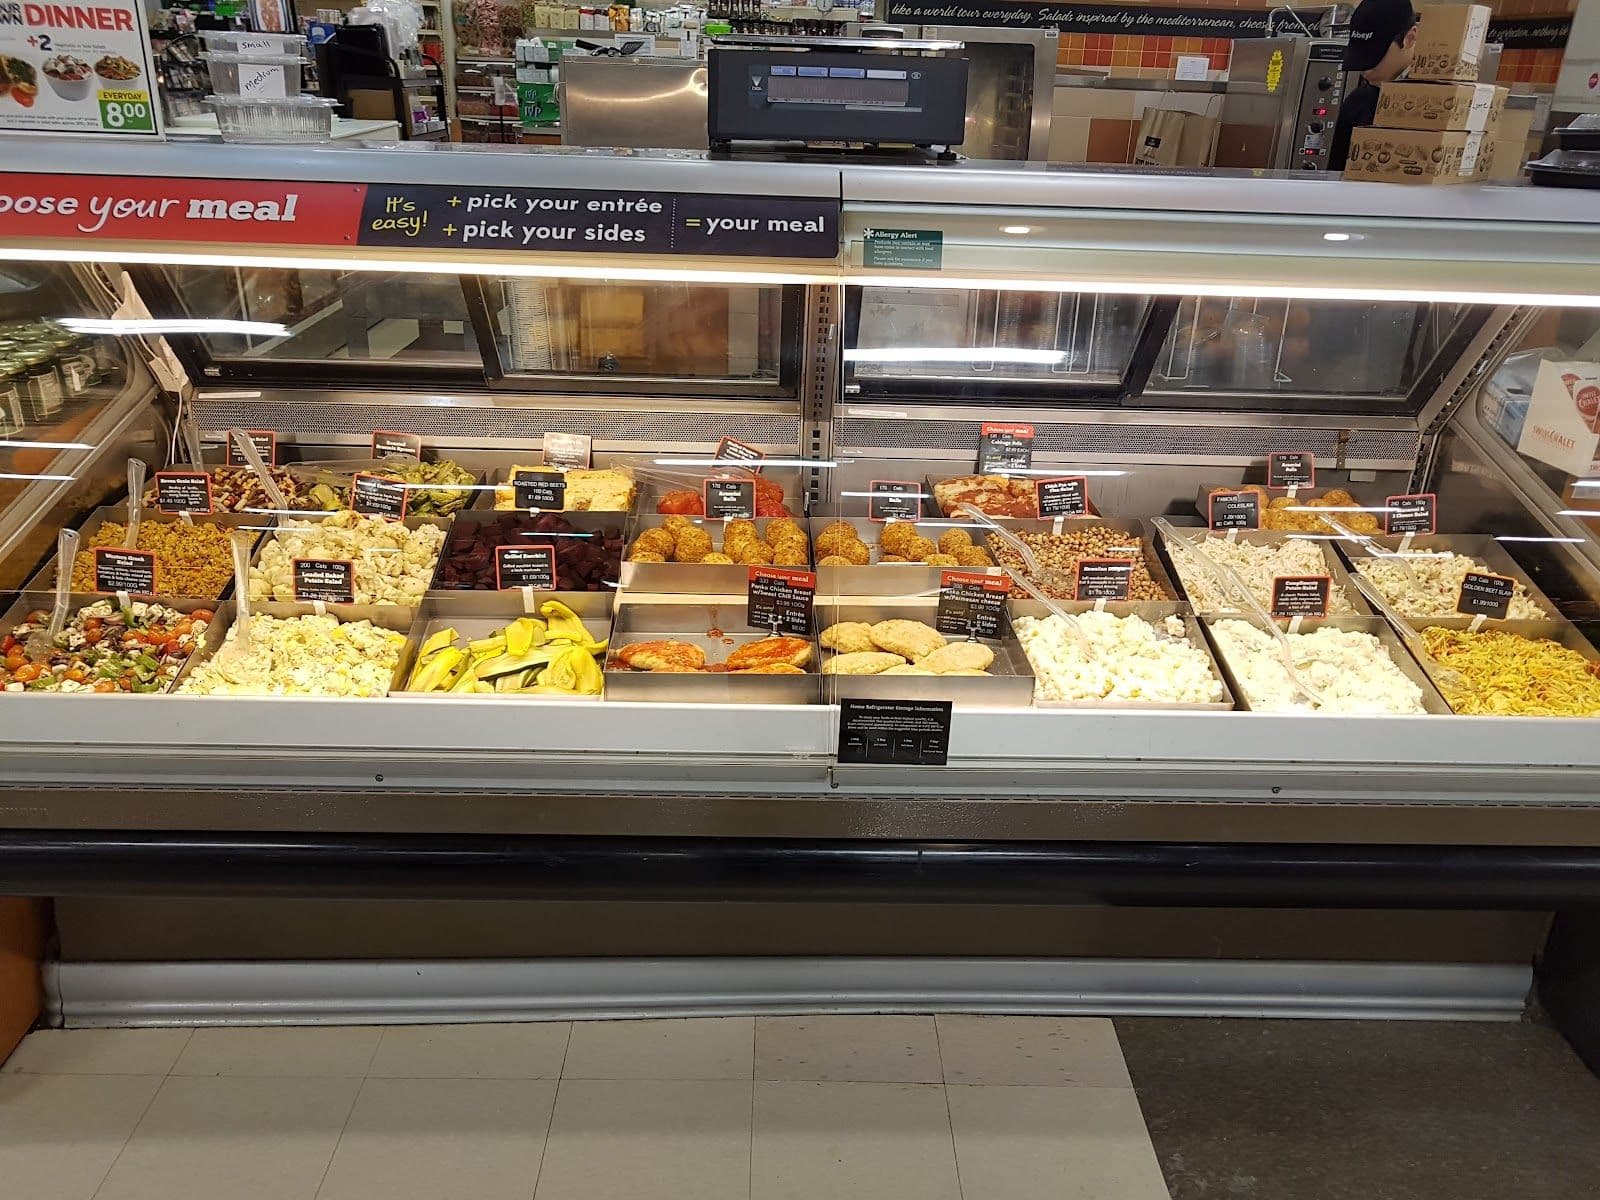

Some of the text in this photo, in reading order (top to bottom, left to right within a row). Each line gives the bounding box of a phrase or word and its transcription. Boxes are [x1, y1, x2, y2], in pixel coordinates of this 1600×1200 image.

[24, 4, 135, 31] DINNER
[891, 3, 912, 16] like
[913, 8, 922, 16] a
[923, 5, 956, 17] world
[957, 8, 981, 18] tour
[1038, 8, 1074, 22] Salads
[1075, 11, 1119, 25] inspired
[1120, 14, 1135, 27] by
[1136, 12, 1155, 25] the
[103, 91, 142, 100] EVERYDAY
[386, 195, 416, 213] It's
[467, 194, 518, 212] pick
[525, 199, 580, 214] your
[586, 197, 663, 214] entrée
[77, 195, 181, 233] your
[186, 194, 298, 222] meal
[371, 210, 429, 237] easy!
[463, 220, 514, 242] pick
[522, 225, 577, 244] your
[584, 223, 647, 243] sides
[706, 216, 760, 235] your
[766, 215, 825, 233] meal
[874, 231, 899, 239] Allergy
[1550, 430, 1576, 449] CHALET
[751, 582, 769, 591] Panko
[769, 585, 793, 594] Chicken
[791, 575, 809, 583] meal
[792, 594, 810, 602] Sauce
[960, 590, 985, 598] Chicken
[985, 593, 1005, 601] Breast
[1463, 583, 1513, 597] GOLDEN BEET SLAW
